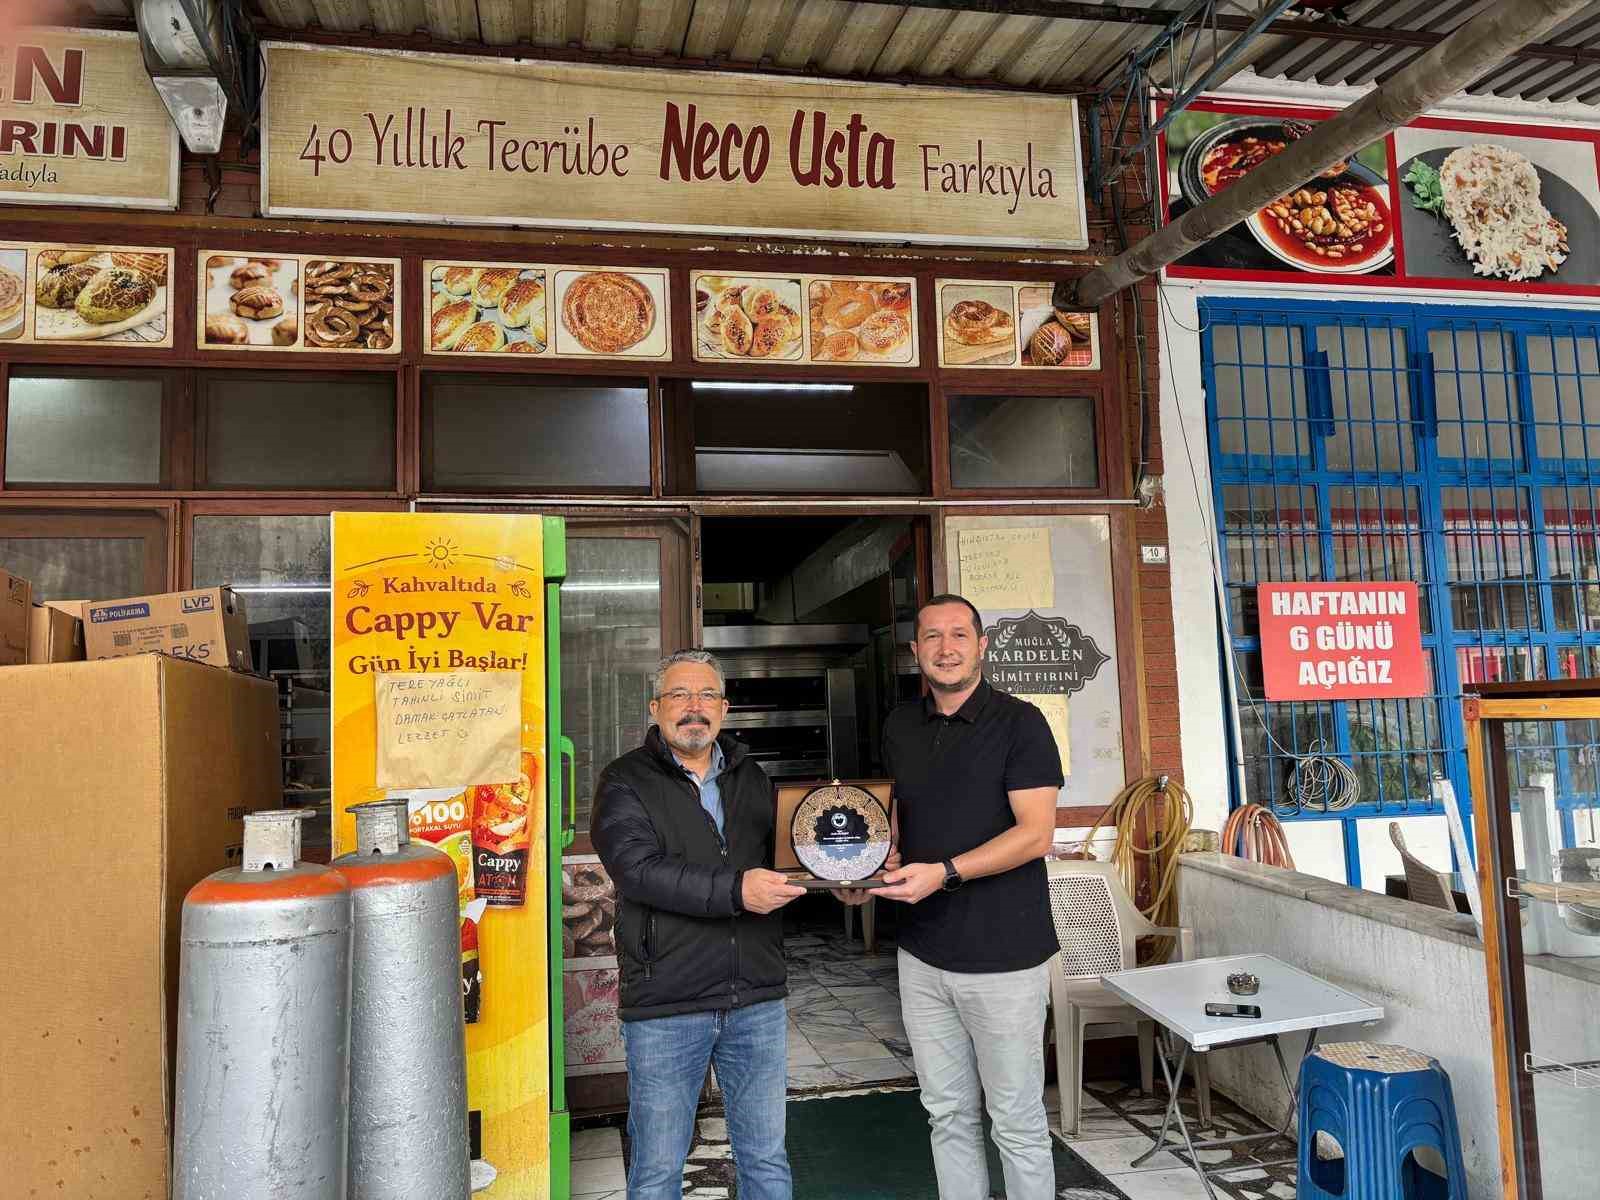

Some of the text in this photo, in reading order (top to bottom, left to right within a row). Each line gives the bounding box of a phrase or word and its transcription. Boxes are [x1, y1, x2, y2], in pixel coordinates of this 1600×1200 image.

[299, 100, 1058, 215] 40 Yıllık Tecrübe Neco Usta Farkıyla
[383, 576, 497, 594] Kahvaltıda
[183, 596, 211, 610] LVP
[1271, 590, 1407, 617] HAFTANIN
[345, 601, 535, 641] Cappy Var
[1289, 619, 1394, 651] 6 GÜNÜ
[348, 644, 529, 676] Gün İyi Başlar!
[987, 649, 1084, 663] KARDELEN
[1298, 655, 1393, 690] AÇIĞIZ
[478, 853, 521, 873] Cappy
